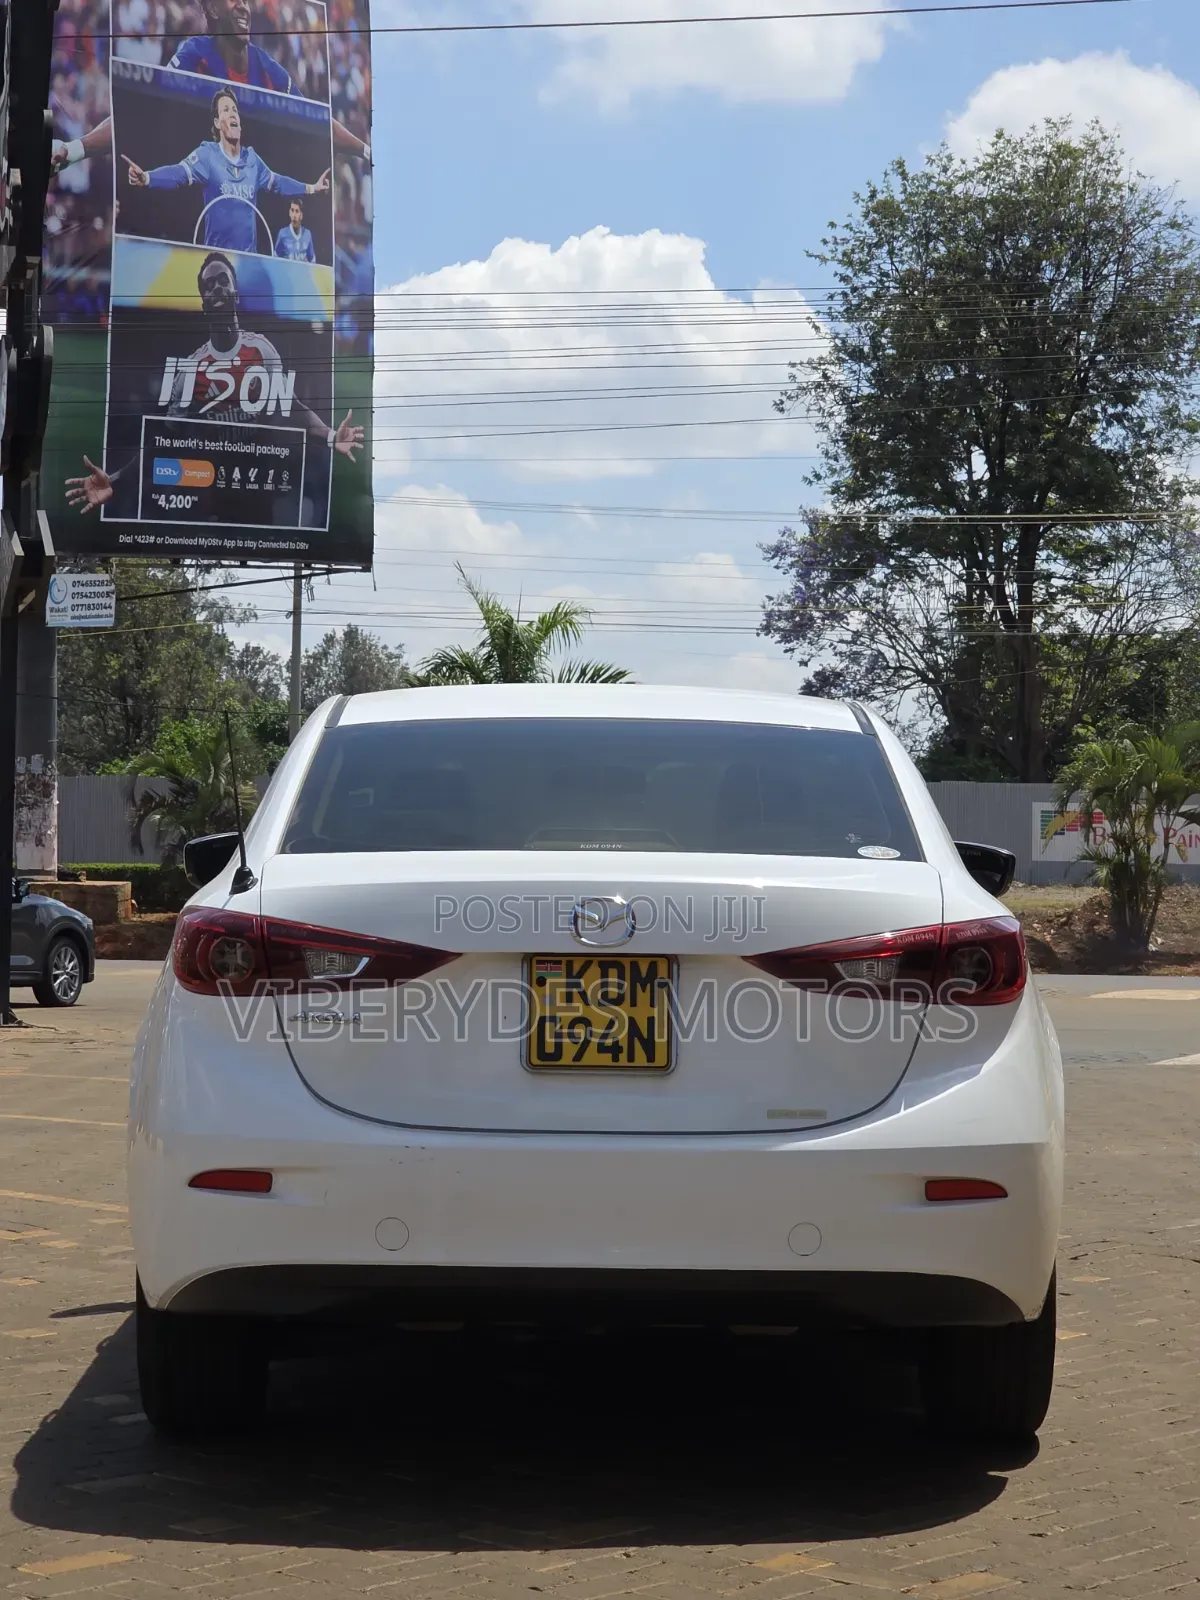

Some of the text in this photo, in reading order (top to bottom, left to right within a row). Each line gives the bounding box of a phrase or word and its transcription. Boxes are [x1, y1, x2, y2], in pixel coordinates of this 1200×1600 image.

[240, 365, 296, 417] ON
[154, 436, 290, 459] The world's best football package
[156, 467, 211, 479] DStv Compact
[158, 494, 192, 511] 4,200
[119, 534, 133, 543] Dial
[164, 536, 198, 545] Download
[198, 537, 222, 549] MyDStv
[222, 538, 236, 549] App
[236, 539, 244, 547] to
[244, 540, 258, 550] stay
[258, 540, 289, 549] Connected
[289, 541, 296, 549] to
[296, 542, 309, 550] DStv
[71, 591, 114, 600] 075423005
[70, 602, 113, 612] 0771830144
[565, 960, 658, 1008] KDM
[536, 1015, 656, 1063] 094N
